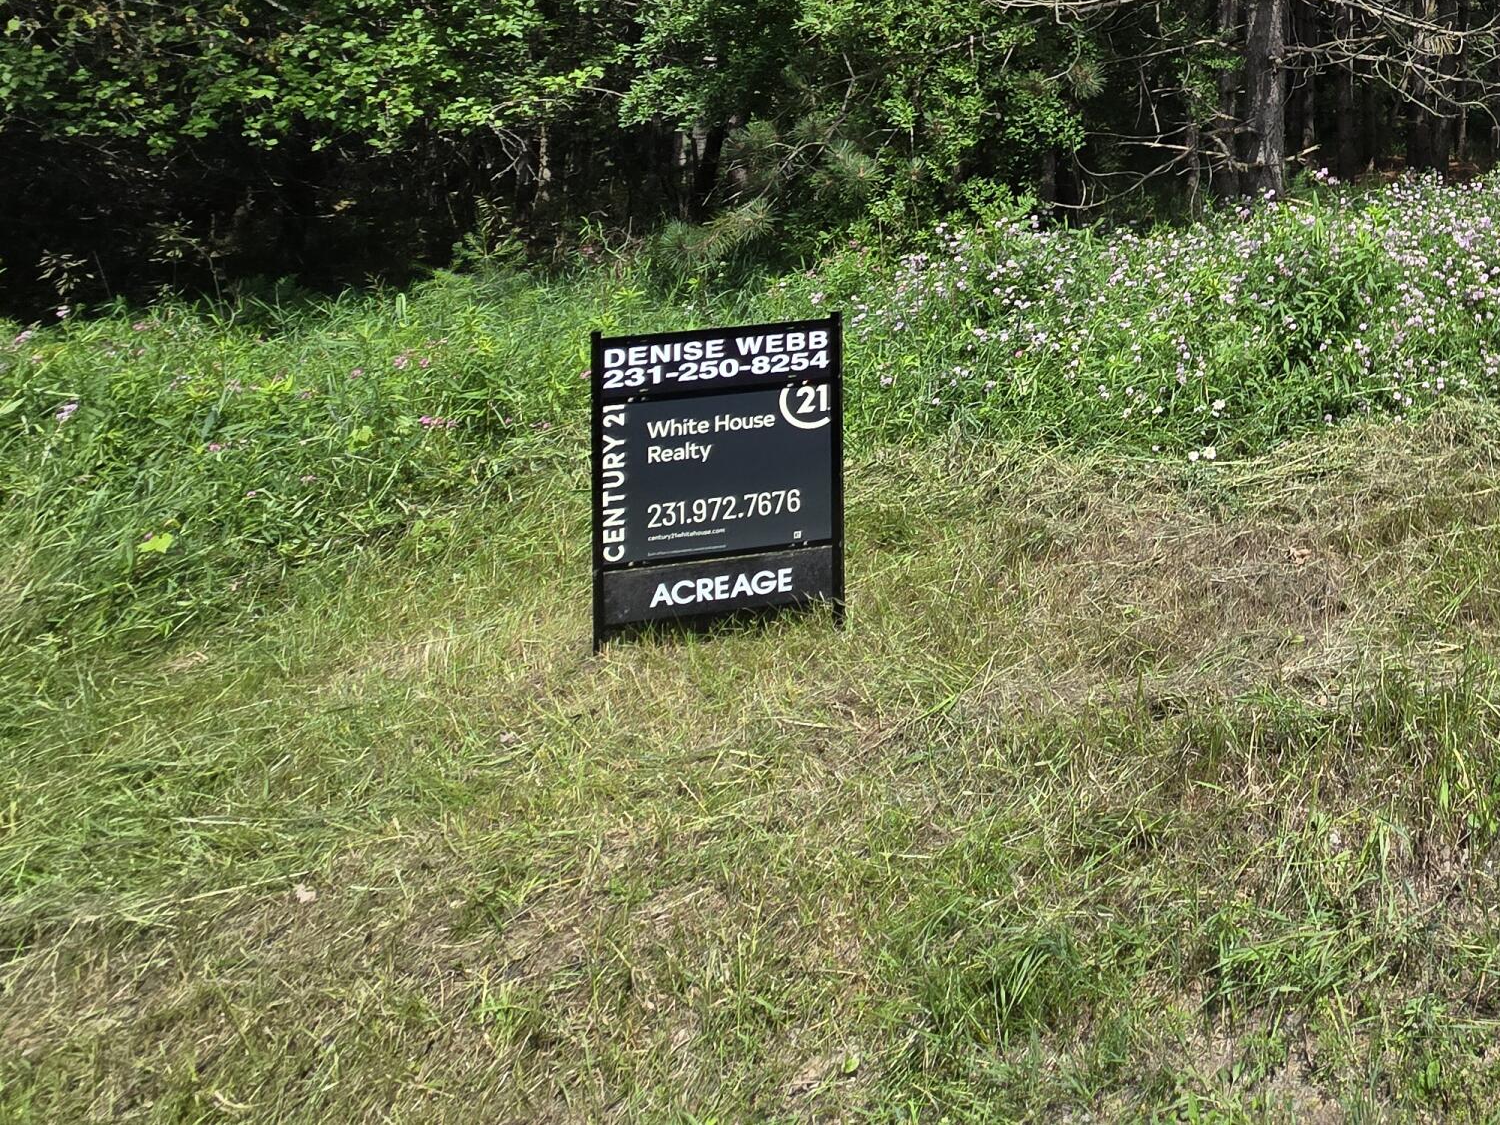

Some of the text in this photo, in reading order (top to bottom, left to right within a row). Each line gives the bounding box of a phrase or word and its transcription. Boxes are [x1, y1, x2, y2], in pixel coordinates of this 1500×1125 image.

[604, 331, 829, 368] DENISE WEBB
[603, 350, 829, 389] 231-250-8254
[647, 413, 775, 439] White House
[647, 442, 712, 463] Realty
[603, 404, 625, 562] CENTURY 21
[647, 488, 801, 529] 231.972.7676
[650, 568, 793, 608] ACREAGE
